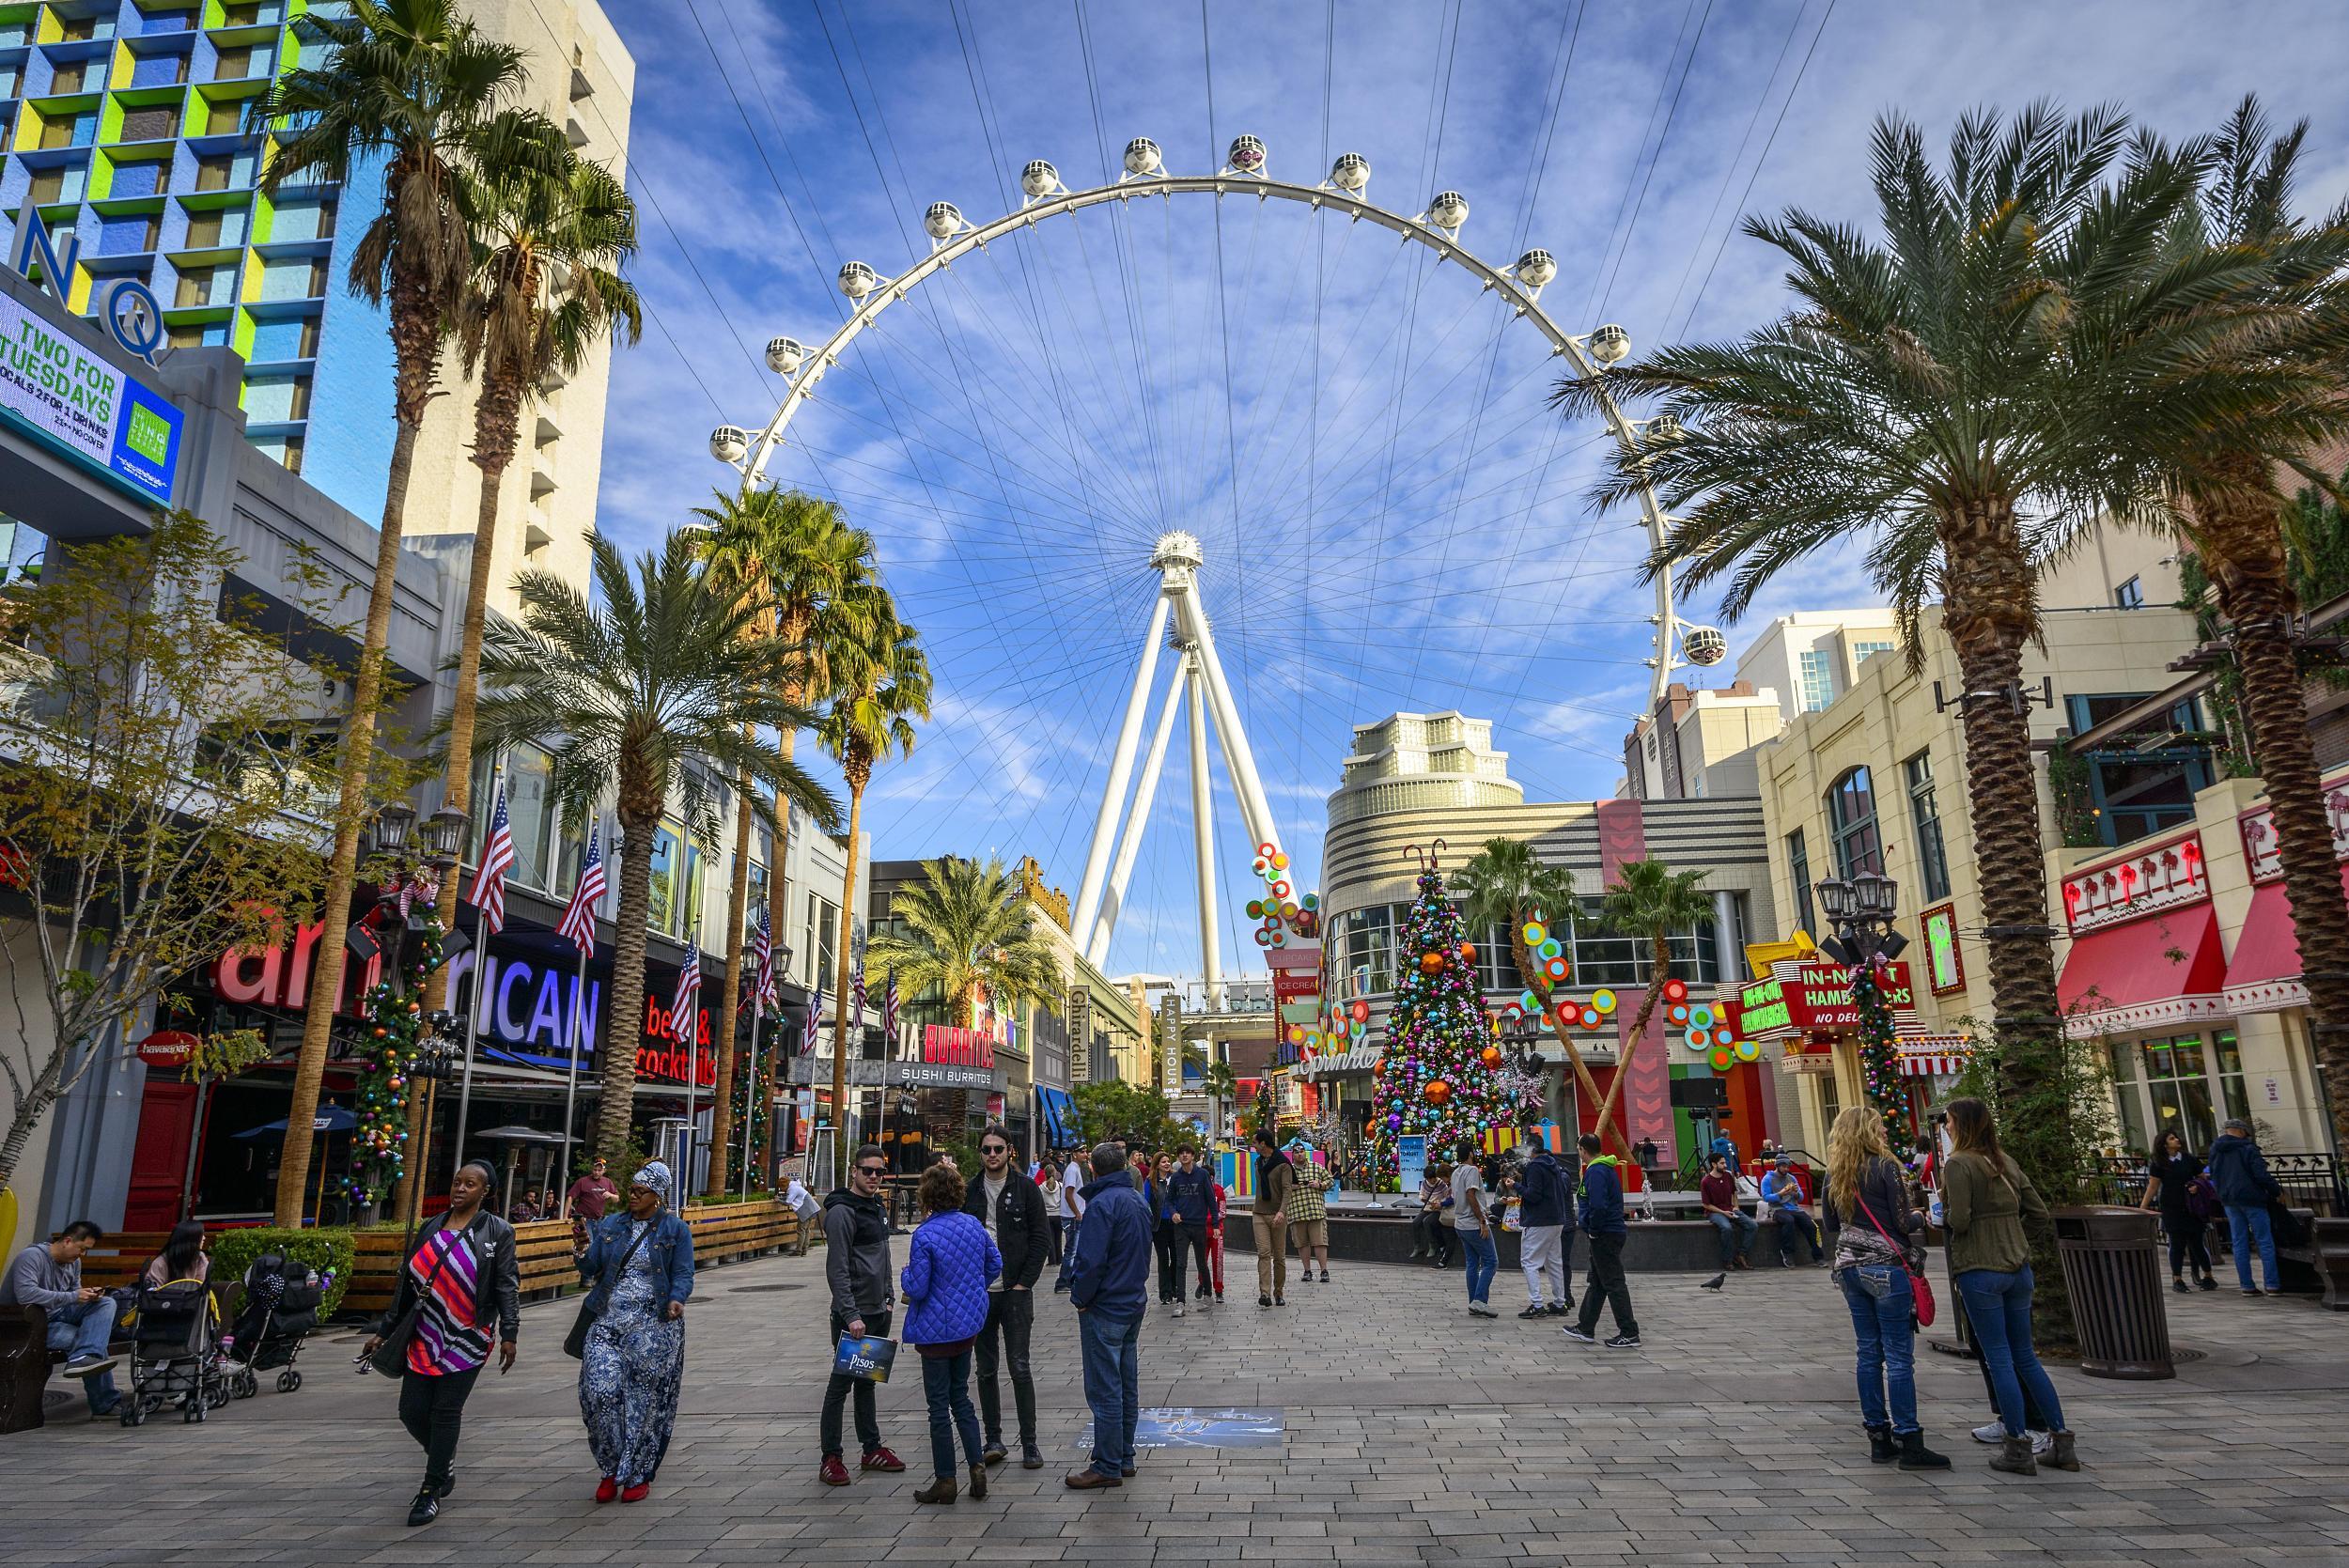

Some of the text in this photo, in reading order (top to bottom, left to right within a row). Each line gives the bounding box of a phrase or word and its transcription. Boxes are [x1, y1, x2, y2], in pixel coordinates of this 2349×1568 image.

[0, 334, 111, 423] TUESDAYS
[21, 318, 116, 399] TWO FOR
[0, 365, 35, 395] OCALS
[42, 392, 63, 412] FOR
[73, 410, 108, 439] DRINKS
[83, 433, 104, 451] COVER
[1278, 981, 1315, 990] ICE CREA
[696, 1008, 710, 1046] &
[1071, 990, 1086, 1079] Ghirardelli
[1167, 999, 1176, 1042] HAPPY
[1815, 1014, 1833, 1023] NO
[635, 1041, 716, 1086] cocktils
[895, 1022, 996, 1069] JA BURRITOS
[1167, 1048, 1176, 1085] HOUR
[1299, 1034, 1382, 1083] Sprinkle
[901, 1068, 991, 1084] SUSHI BURRITOS
